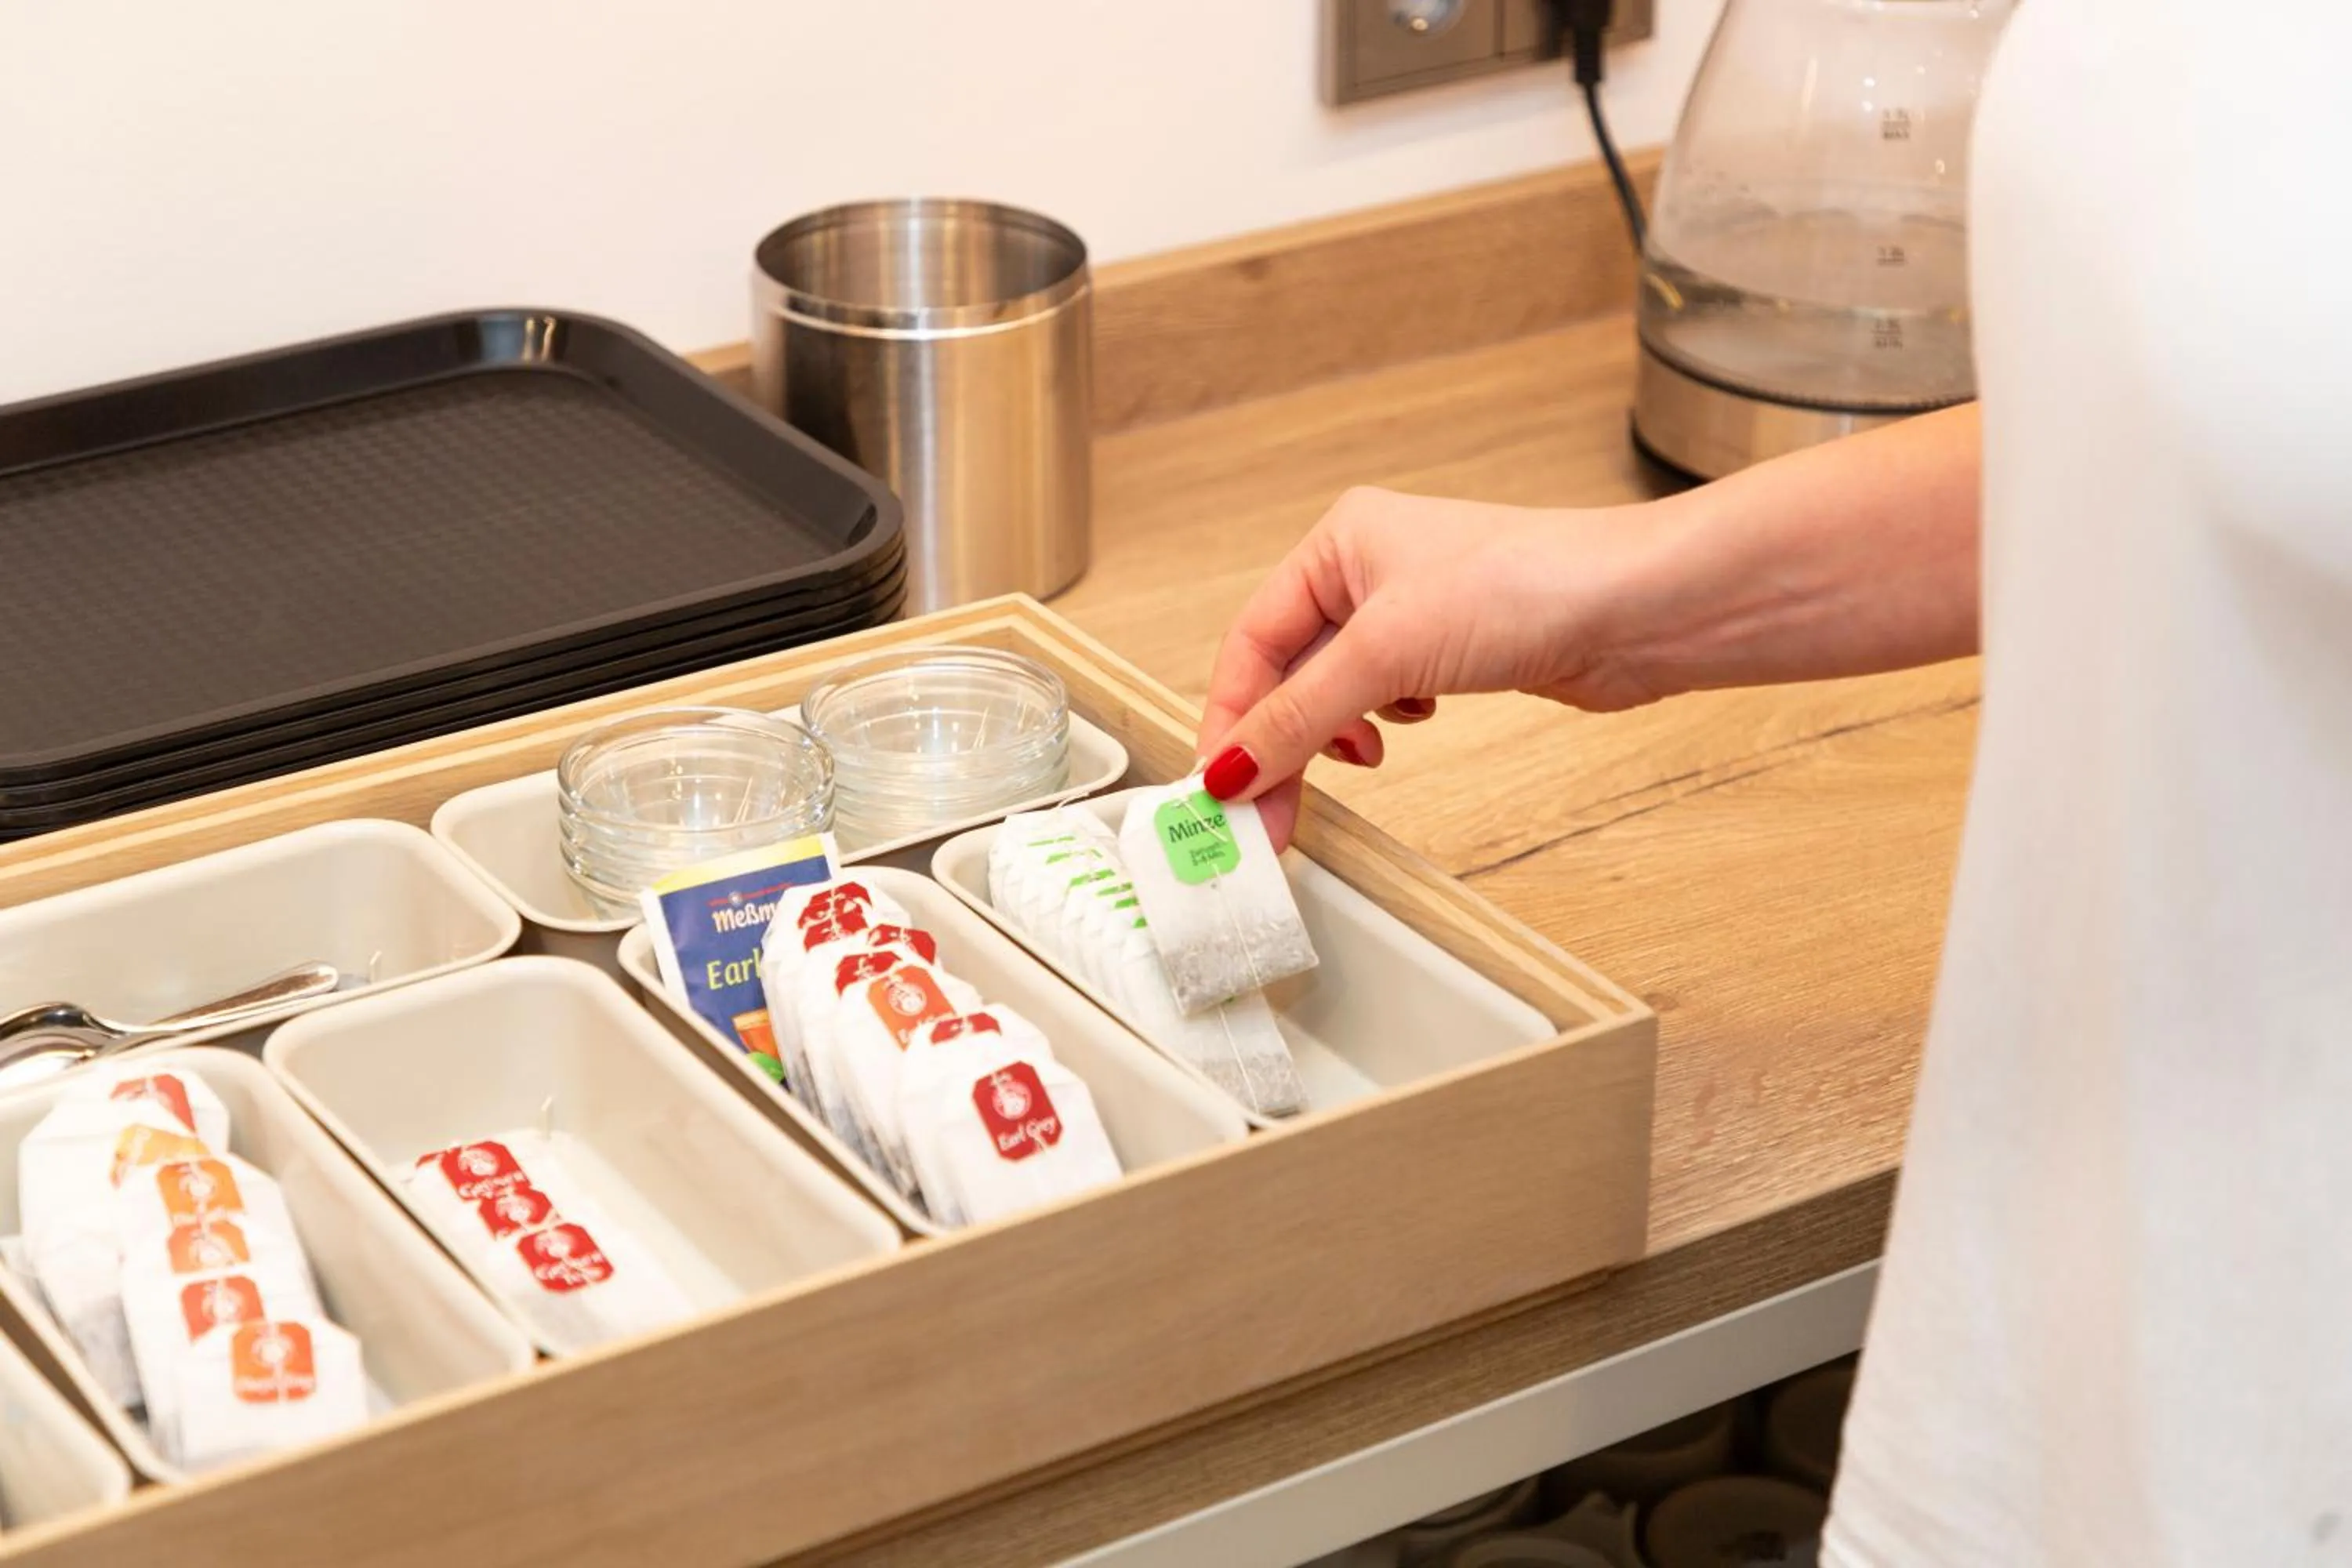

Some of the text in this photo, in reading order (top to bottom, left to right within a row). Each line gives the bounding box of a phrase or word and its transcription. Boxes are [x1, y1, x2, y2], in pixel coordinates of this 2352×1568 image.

[1167, 812, 1227, 844] Minze
[711, 902, 778, 934] Meßm
[706, 947, 762, 990] Earl
